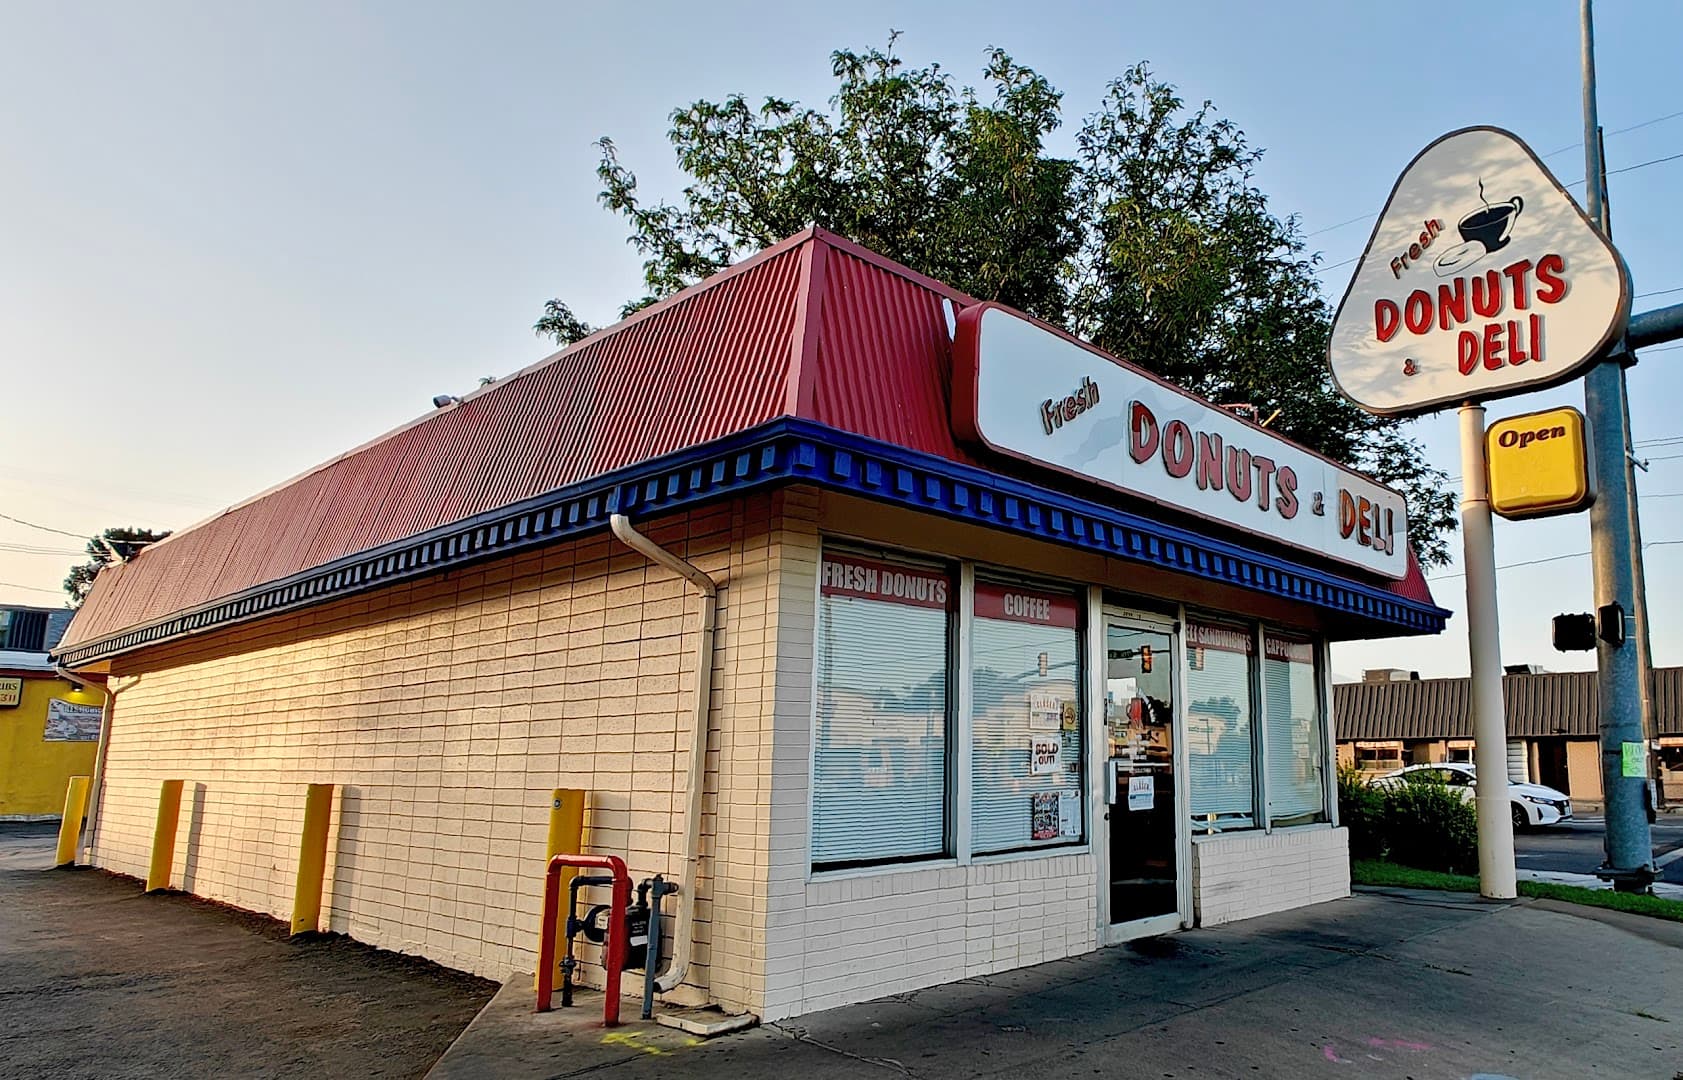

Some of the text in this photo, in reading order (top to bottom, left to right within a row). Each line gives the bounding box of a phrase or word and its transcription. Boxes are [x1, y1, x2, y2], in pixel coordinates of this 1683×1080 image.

[1390, 219, 1442, 279] Fresh
[1375, 253, 1567, 342] DONUTS
[1403, 313, 1543, 376] & DELI
[1499, 425, 1566, 449] Open
[1041, 376, 1394, 556] Fresh DONUTS & DELI
[822, 561, 947, 604] FRESH DONUTS
[1003, 592, 1050, 620] COFFEE
[1187, 623, 1197, 642] ELI
[1035, 743, 1059, 755] SOLD
